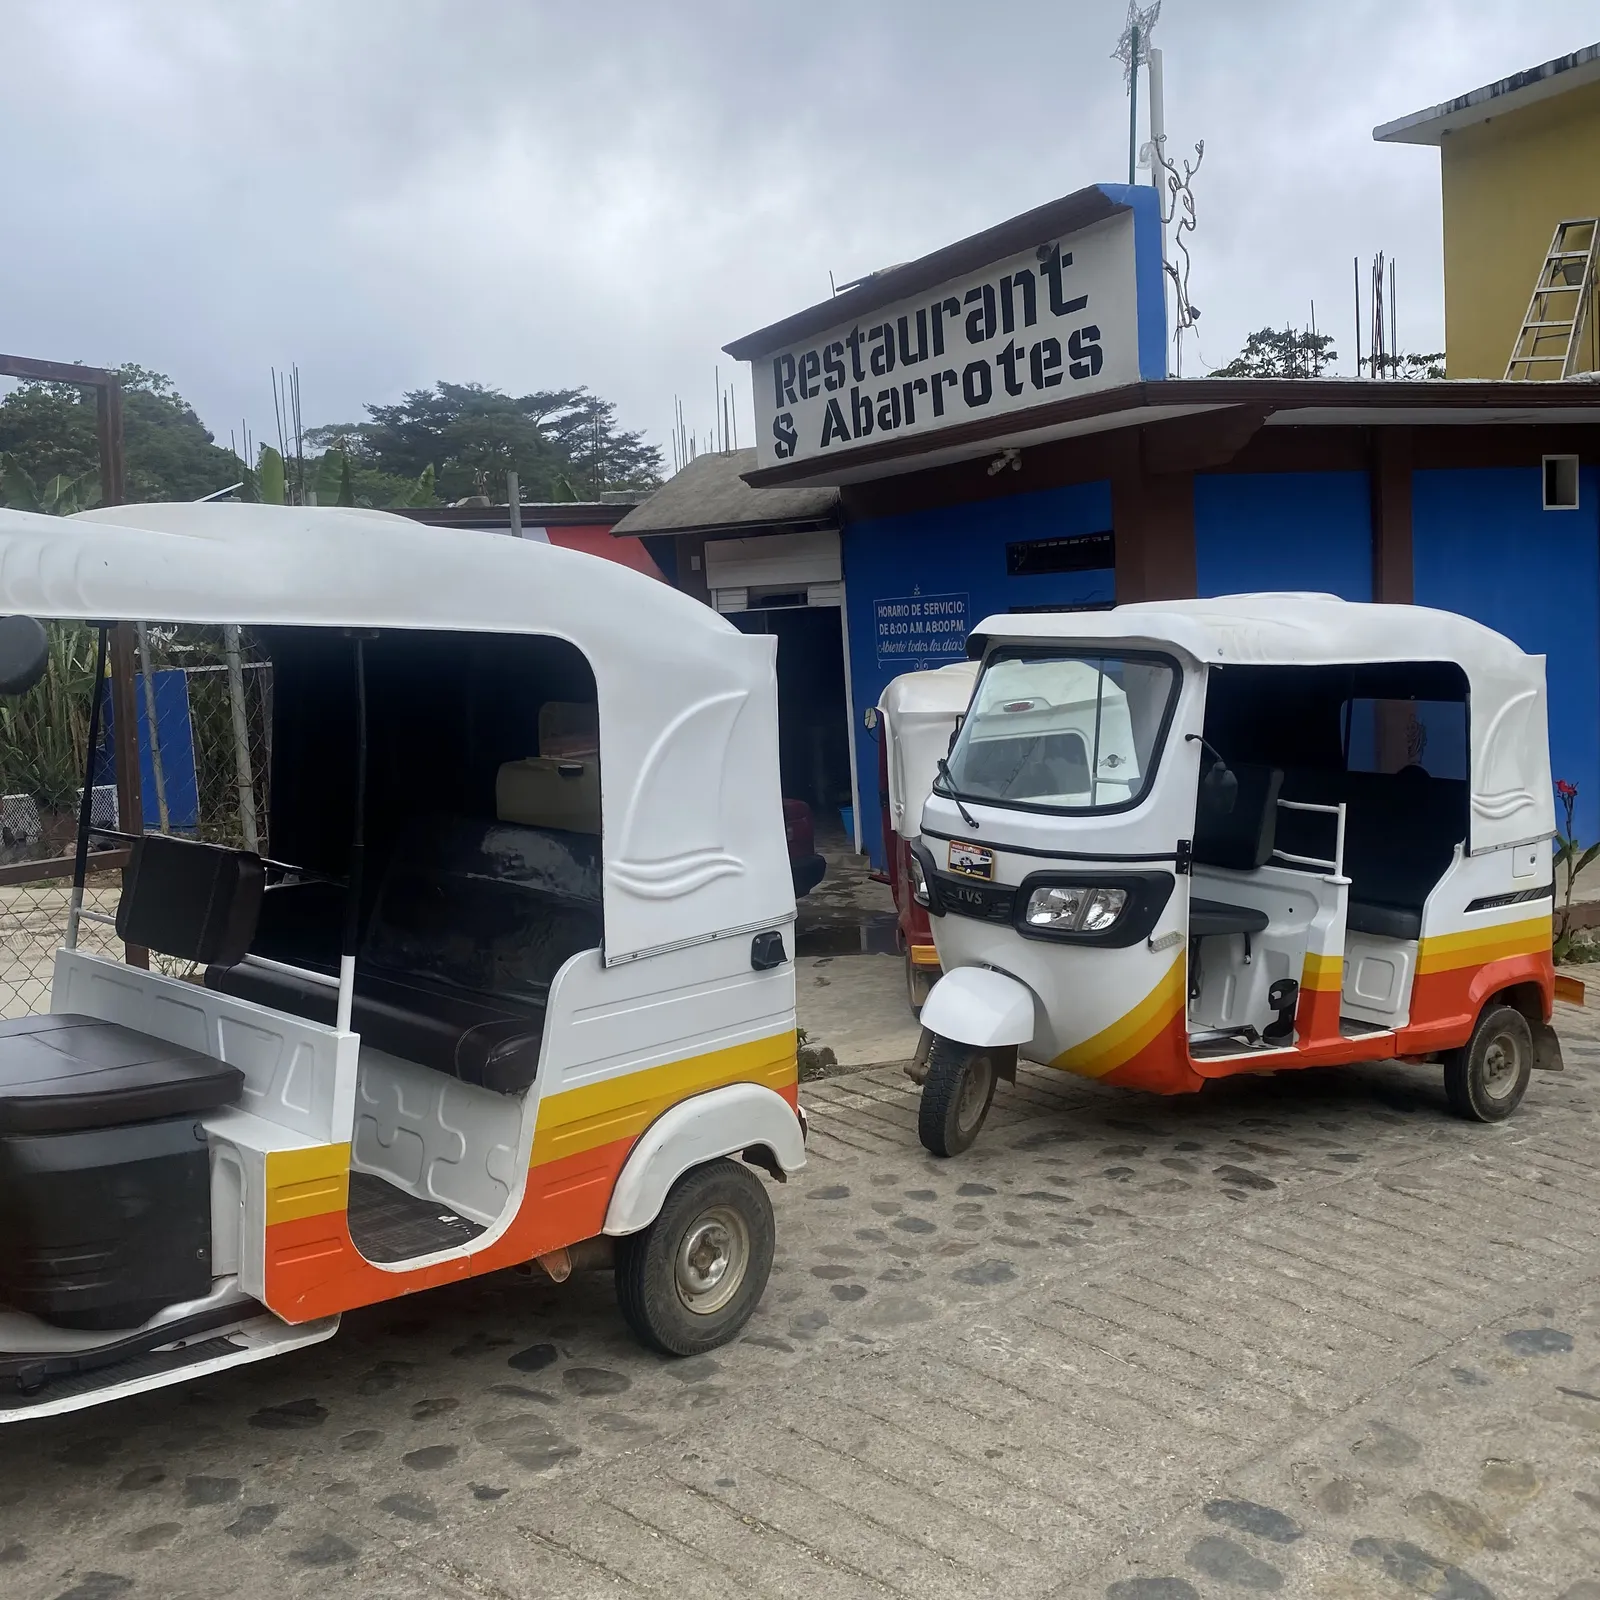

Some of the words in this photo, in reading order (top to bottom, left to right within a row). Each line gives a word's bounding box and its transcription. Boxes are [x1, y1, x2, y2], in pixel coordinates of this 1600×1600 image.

[773, 243, 1089, 408] Restaurant
[820, 324, 1103, 448] Abarrotes
[878, 604, 909, 617] HORARIO
[911, 603, 921, 616] DE
[924, 601, 965, 615] SERVICIO:
[880, 623, 889, 635] DE
[890, 622, 908, 635] 8:00
[951, 619, 966, 632] P.M.
[878, 641, 908, 653] Abierto
[908, 639, 928, 652] todos
[929, 638, 941, 651] los
[958, 888, 983, 904] TVS
